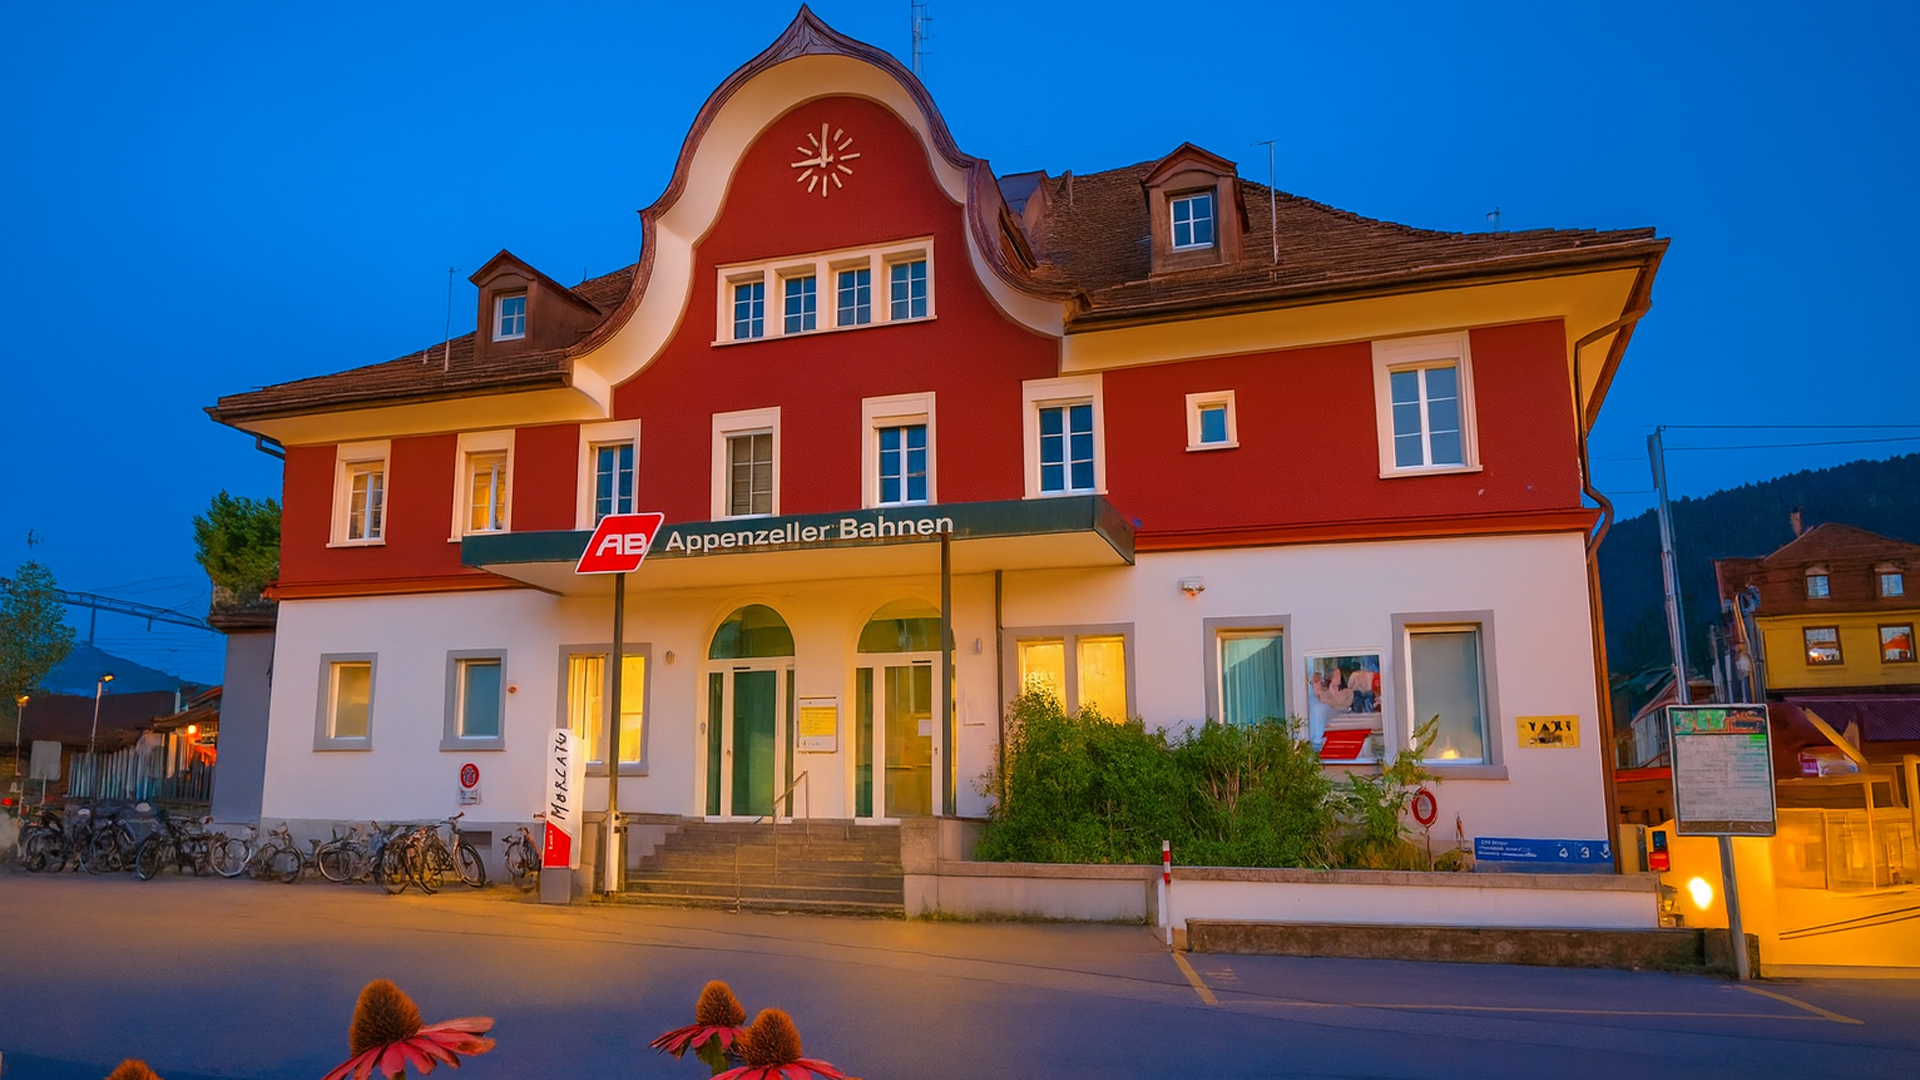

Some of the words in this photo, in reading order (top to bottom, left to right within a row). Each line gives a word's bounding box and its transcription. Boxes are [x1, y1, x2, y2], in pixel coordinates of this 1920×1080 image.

[595, 533, 648, 557] AB
[665, 521, 830, 554] Appenzeller
[839, 515, 954, 540] Bahnen
